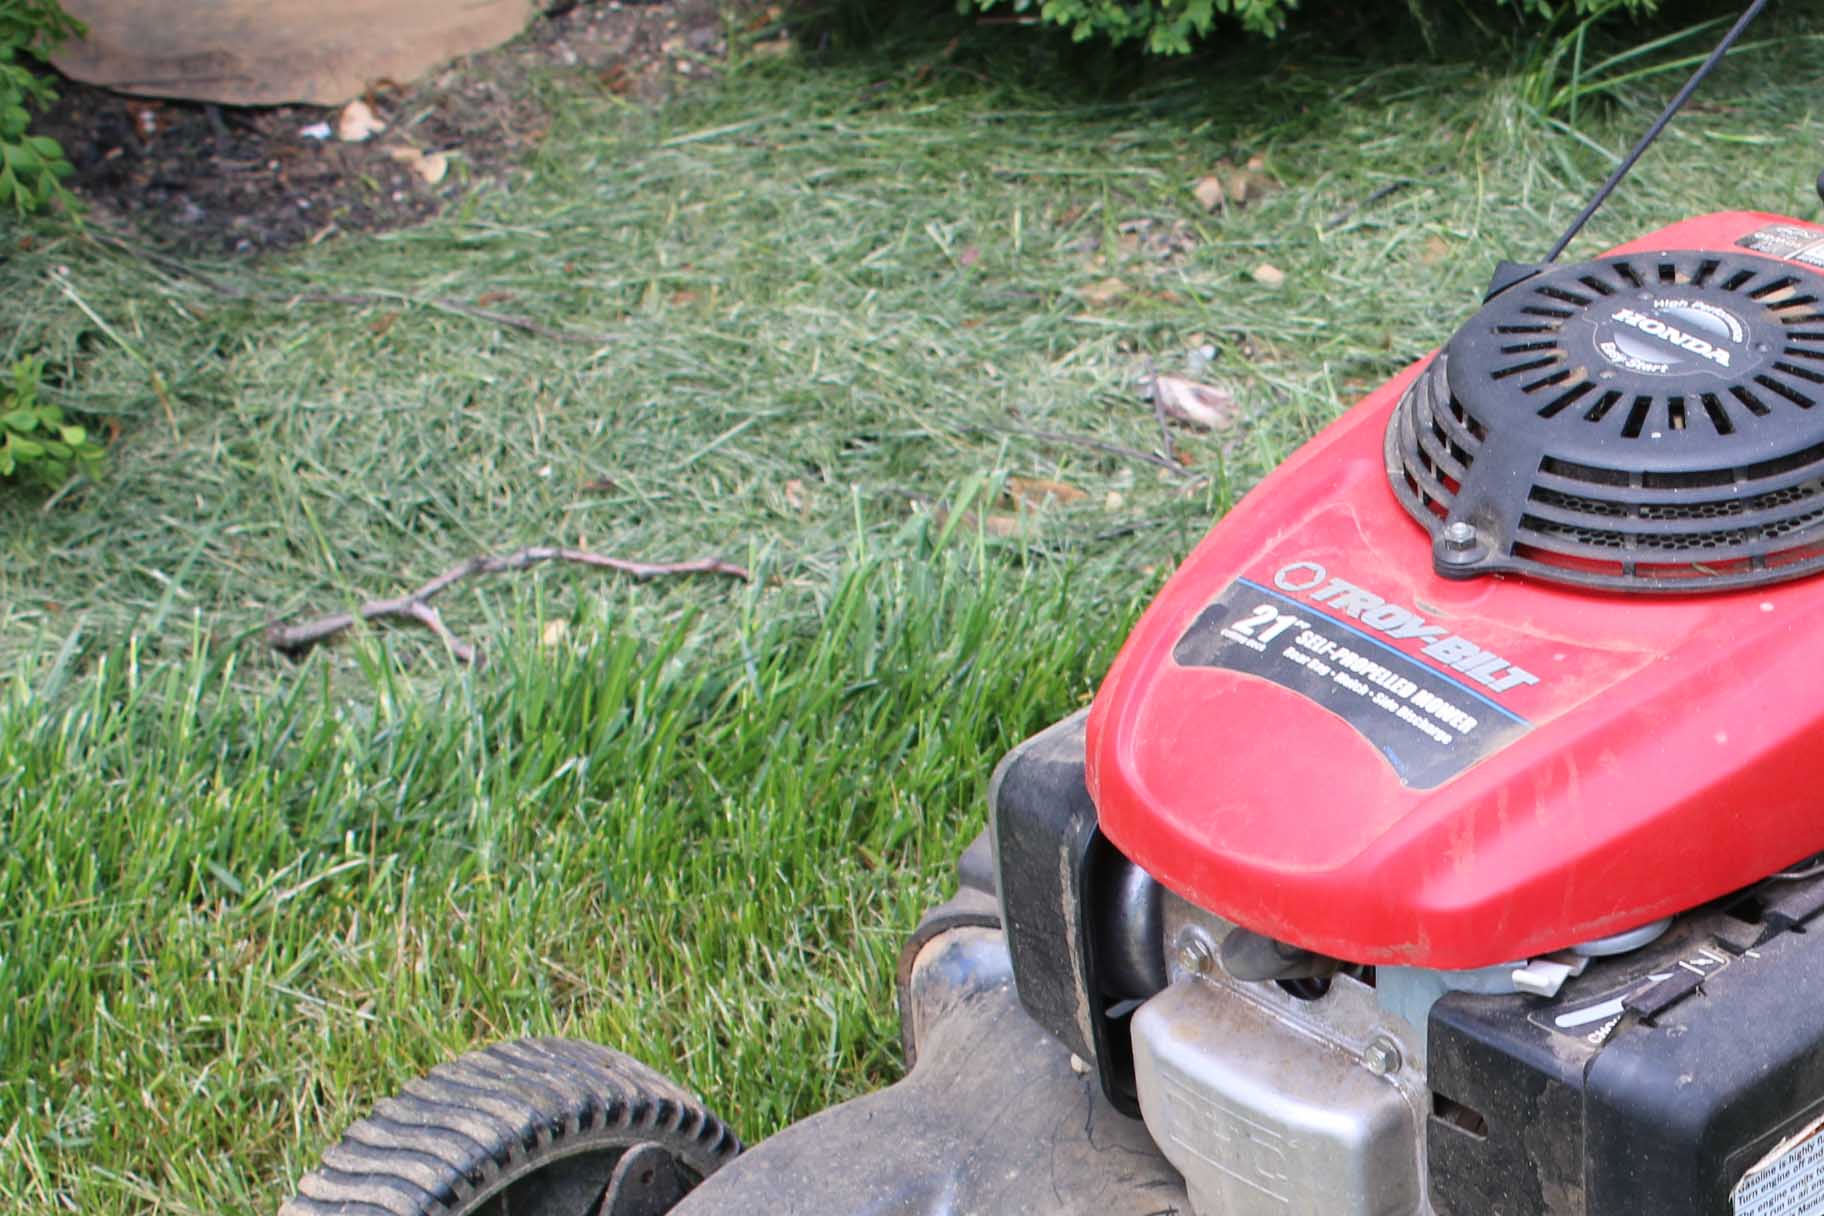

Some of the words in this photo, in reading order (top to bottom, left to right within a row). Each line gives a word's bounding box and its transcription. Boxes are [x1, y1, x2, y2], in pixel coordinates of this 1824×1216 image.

[1653, 299, 1688, 309] High
[1611, 308, 1731, 368] HONDA
[1310, 576, 1541, 693] TROY-BILT
[1295, 630, 1418, 699] SELF-PROPELLED
[1410, 689, 1478, 734] MOWER
[1371, 692, 1400, 713] Side
[1395, 705, 1453, 745] Discharge
[1738, 1167, 1776, 1194] Gasoline
[1779, 1159, 1787, 1168] is
[1788, 1143, 1814, 1163] highly
[1738, 1189, 1758, 1206] Turn
[1760, 1169, 1790, 1193] engine
[1793, 1159, 1805, 1173] off
[1807, 1147, 1824, 1167] and
[1757, 1189, 1788, 1212] engine
[1790, 1173, 1814, 1192] emits
[1769, 1203, 1785, 1216] run
[1787, 1196, 1796, 1205] in
[1798, 1189, 1809, 1199] an
